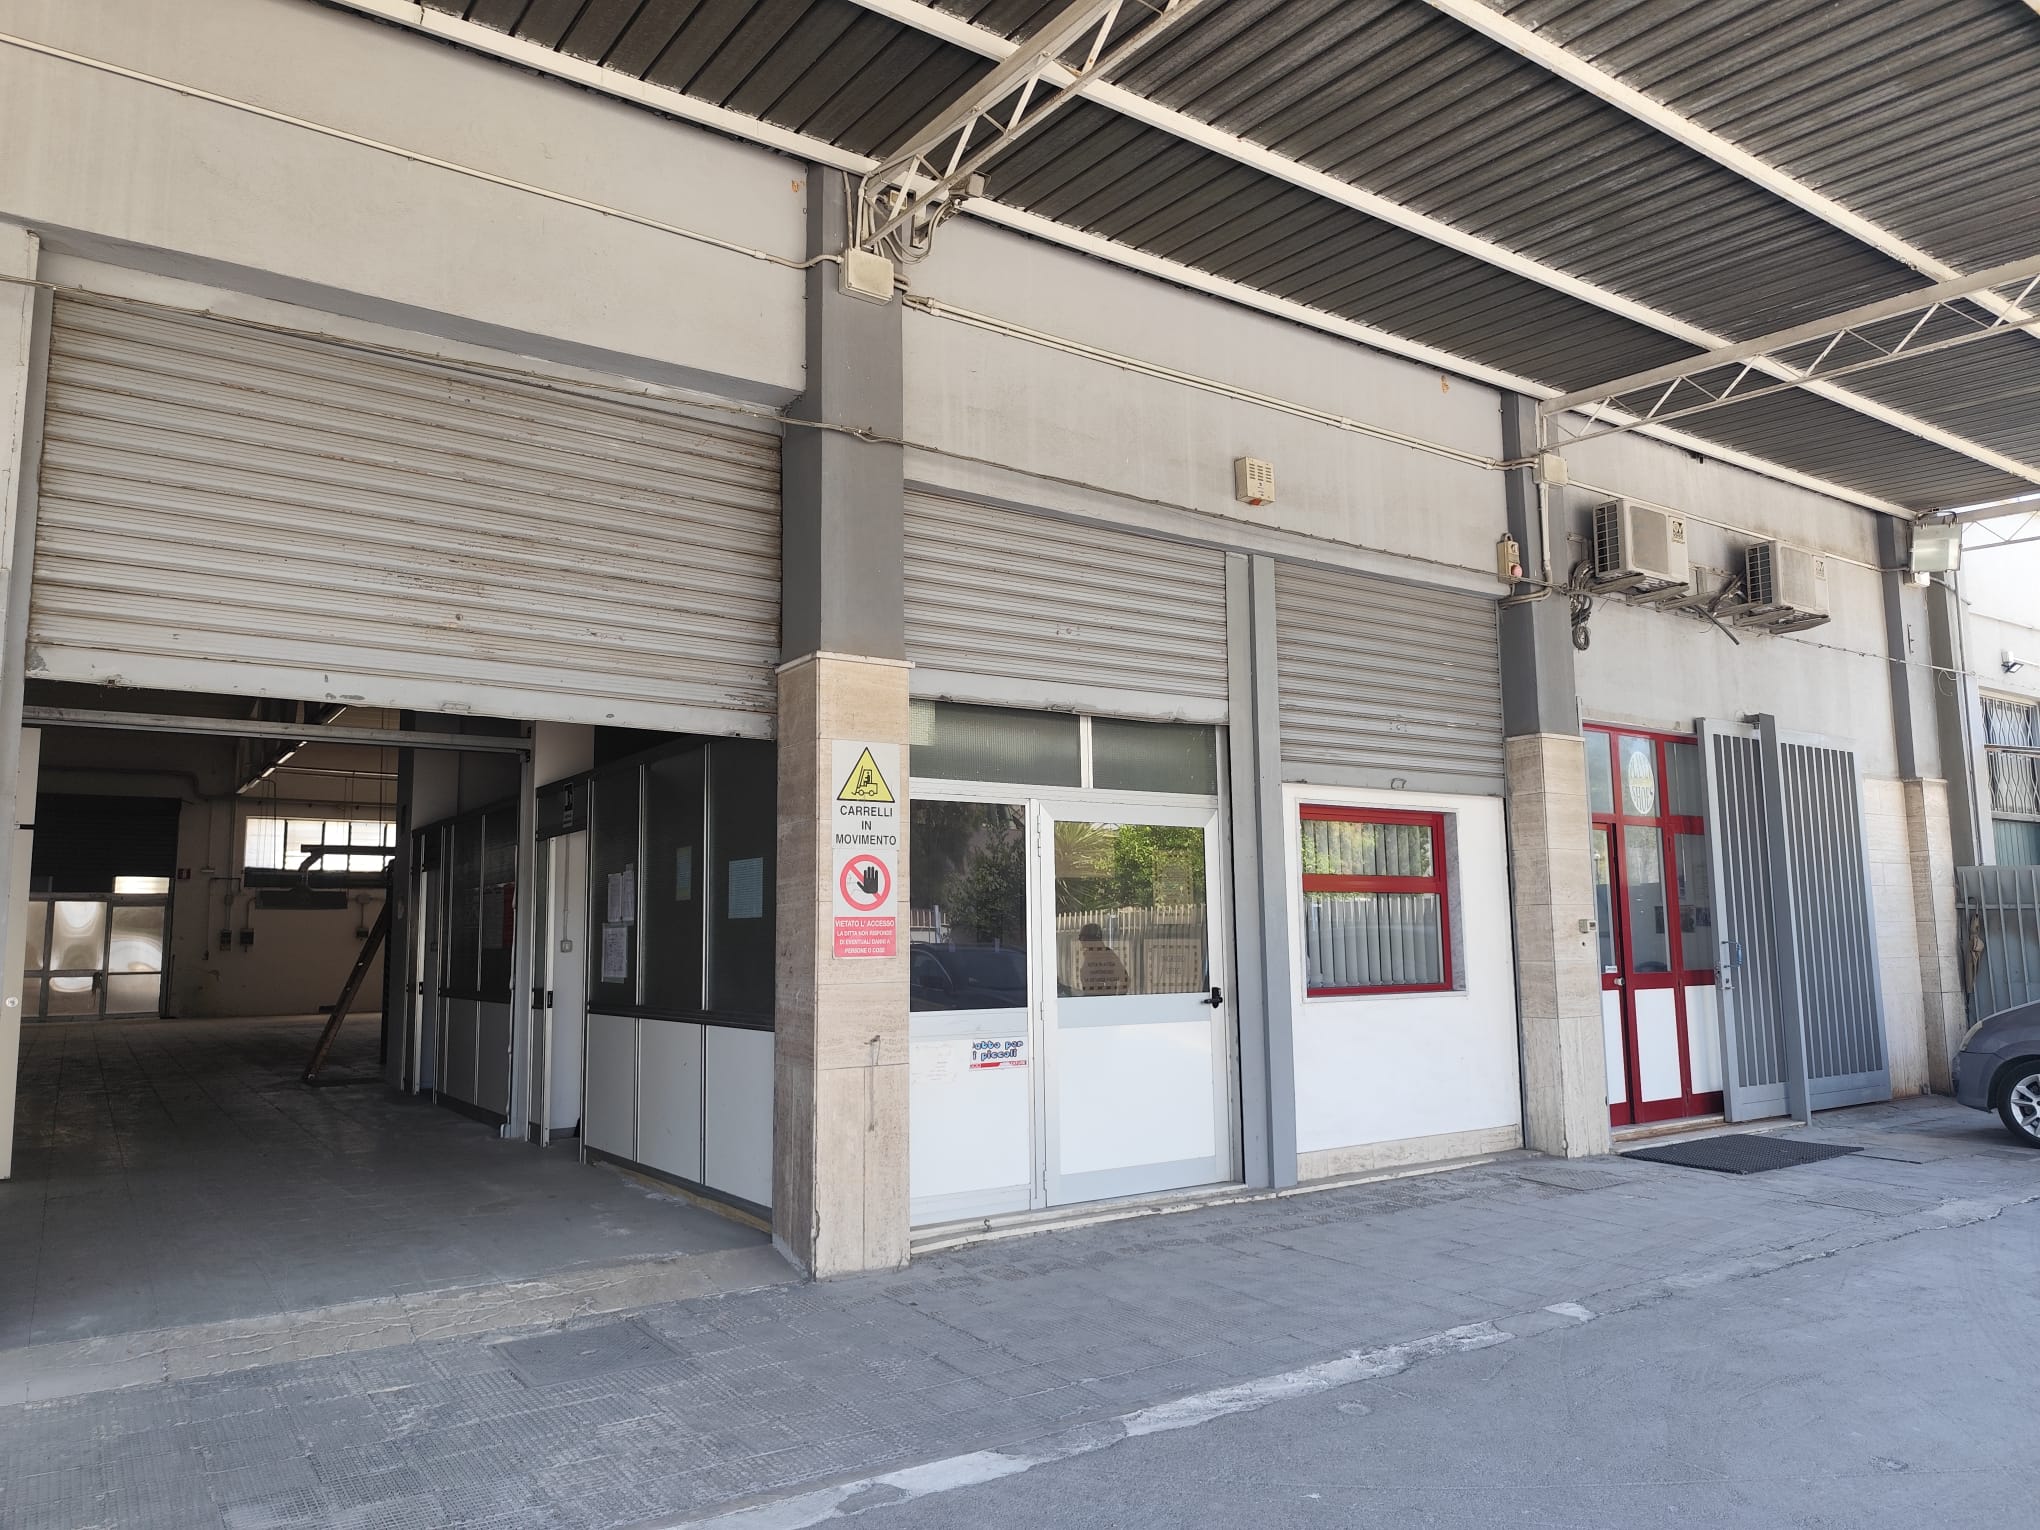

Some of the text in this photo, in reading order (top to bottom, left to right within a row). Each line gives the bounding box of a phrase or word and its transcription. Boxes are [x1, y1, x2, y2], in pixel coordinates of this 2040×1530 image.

[840, 805, 893, 817] CARRELLI
[861, 820, 872, 831] IN
[835, 834, 897, 846] MOVIMENTO
[835, 919, 859, 928] VIETATO
[867, 919, 895, 928] ACCESSO
[1005, 1041, 1024, 1050] per
[981, 1048, 1017, 1061] piccoli
